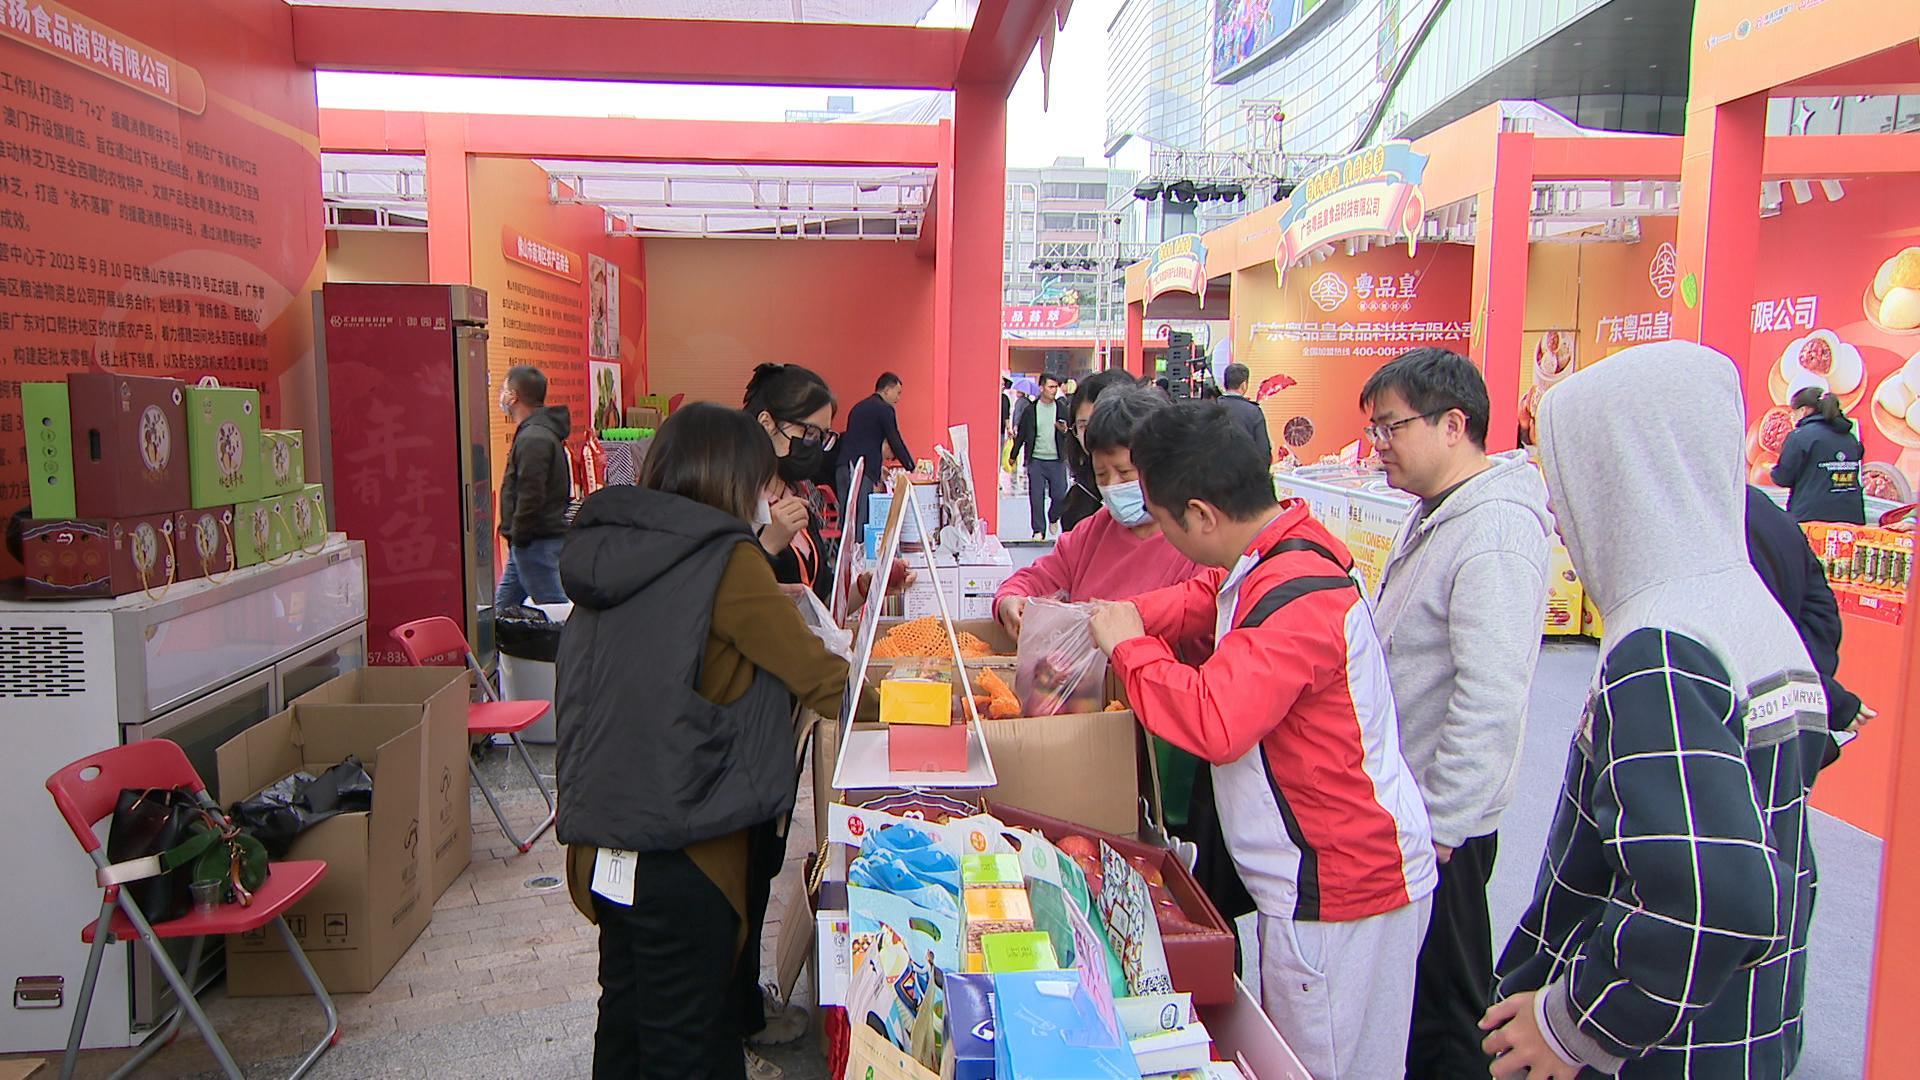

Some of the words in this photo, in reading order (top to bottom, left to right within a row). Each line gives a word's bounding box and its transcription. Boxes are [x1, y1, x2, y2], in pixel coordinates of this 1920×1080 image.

[0, 0, 170, 94] 扬食品商贸有限公司
[1353, 272, 1417, 299] 粤品皇
[1002, 300, 1059, 322] 品荟萃
[1751, 296, 1817, 333] 限公司
[1250, 322, 1472, 342] 广东粤品皇食品科技有限公司
[1595, 311, 1672, 343] 广东粤品皇
[1352, 346, 1416, 357] 400-001-12
[1750, 700, 1778, 721] 3301
